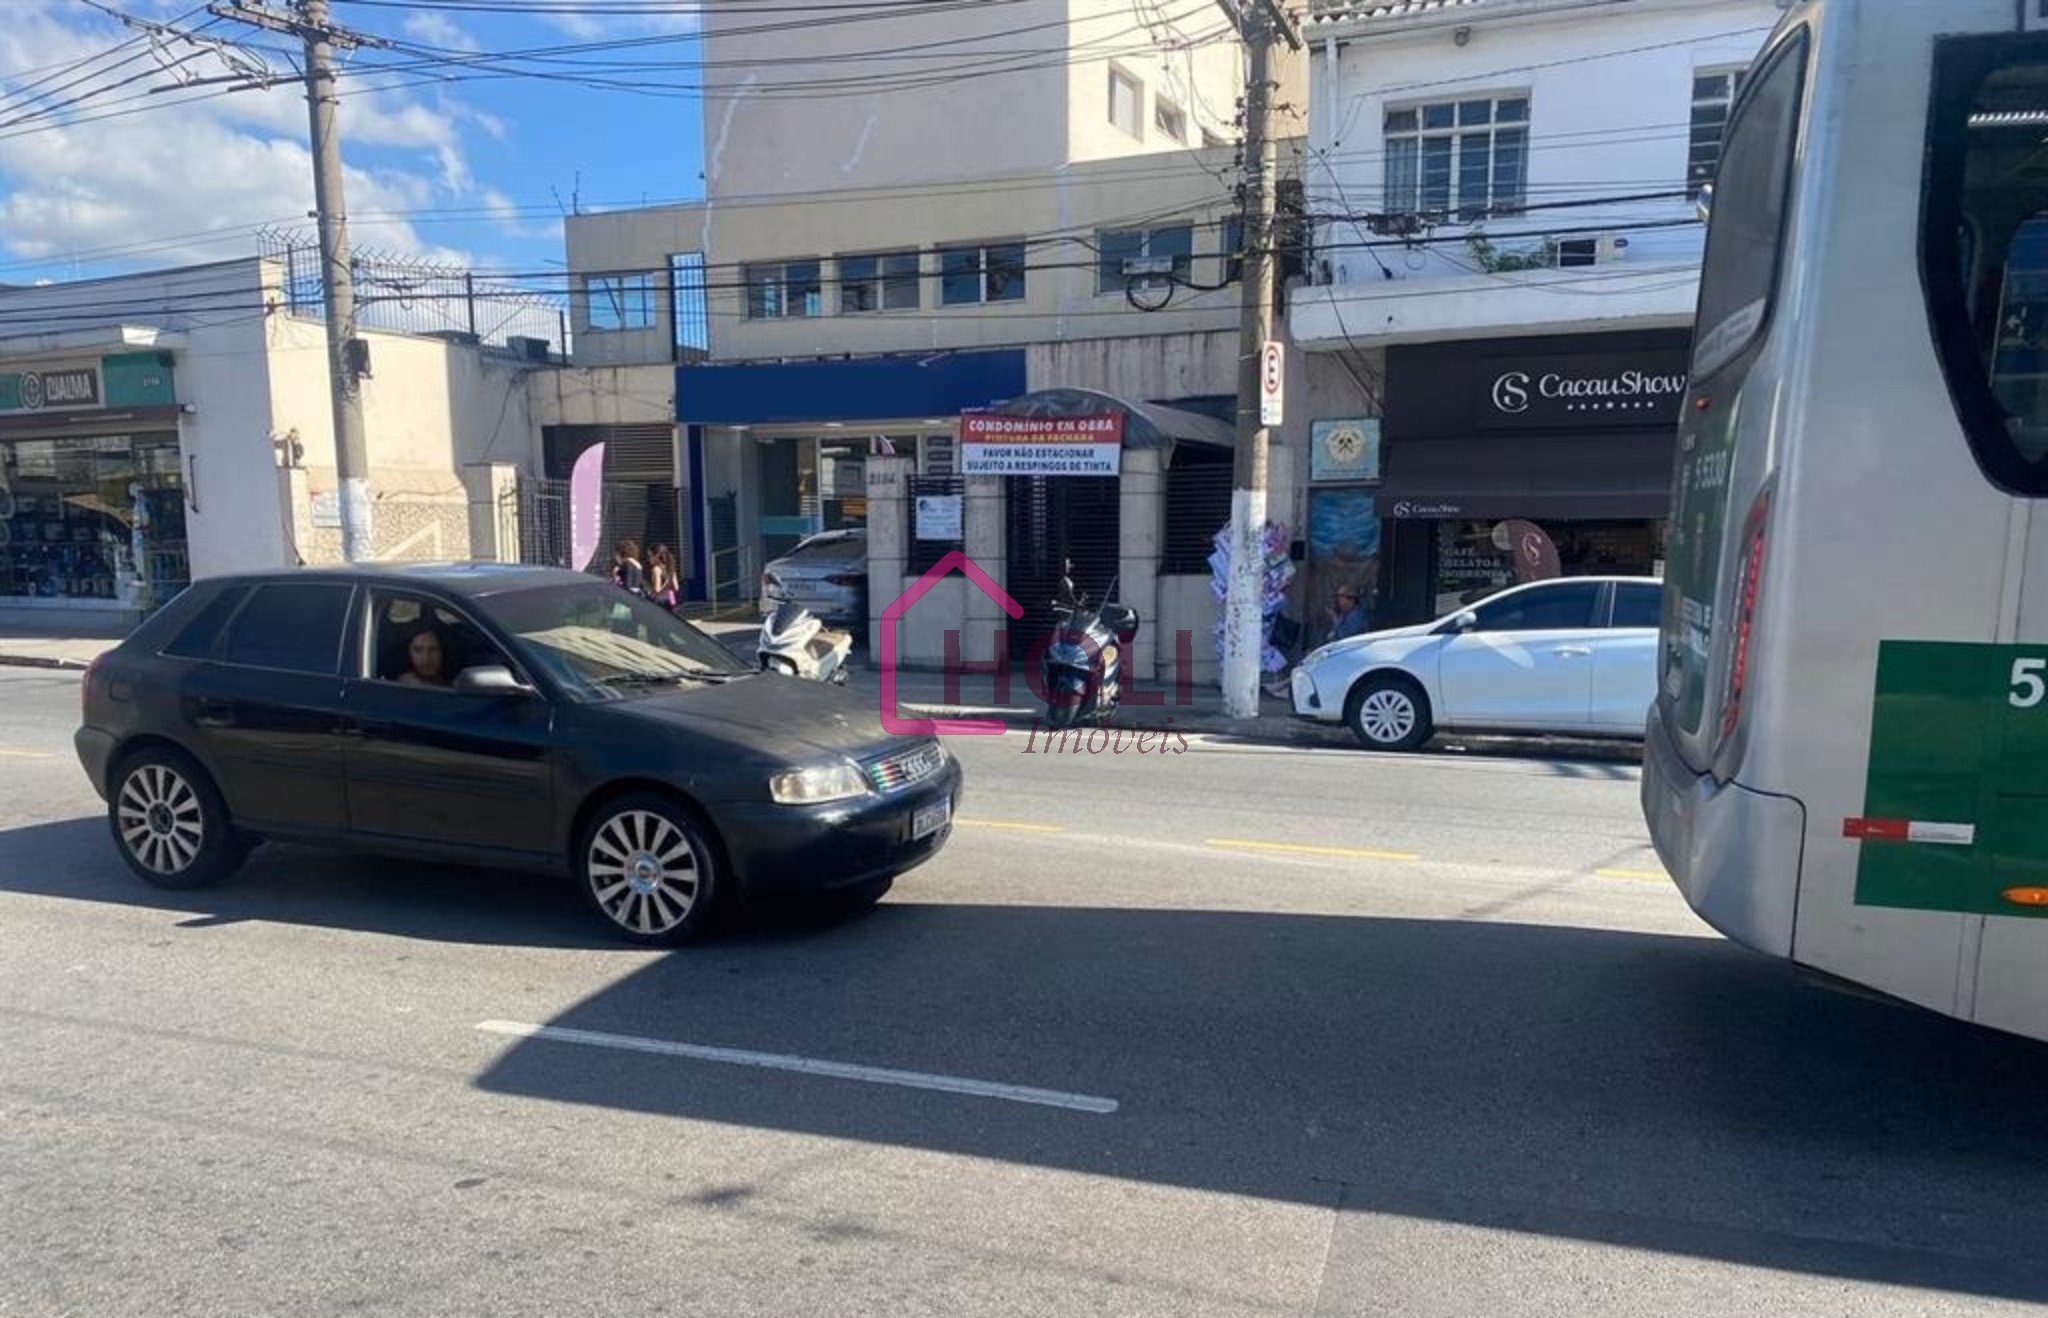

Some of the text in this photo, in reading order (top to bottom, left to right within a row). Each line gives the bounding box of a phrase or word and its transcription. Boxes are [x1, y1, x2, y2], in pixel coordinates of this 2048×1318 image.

[1057, 420, 1075, 431] EM
[1077, 419, 1114, 431] OBRA
[983, 446, 1095, 459] FAVOR NÃO ESTACIONAR
[967, 461, 1112, 471] SUJEITO A RESPINGOS DE TINTA
[2009, 657, 2046, 708] 5
